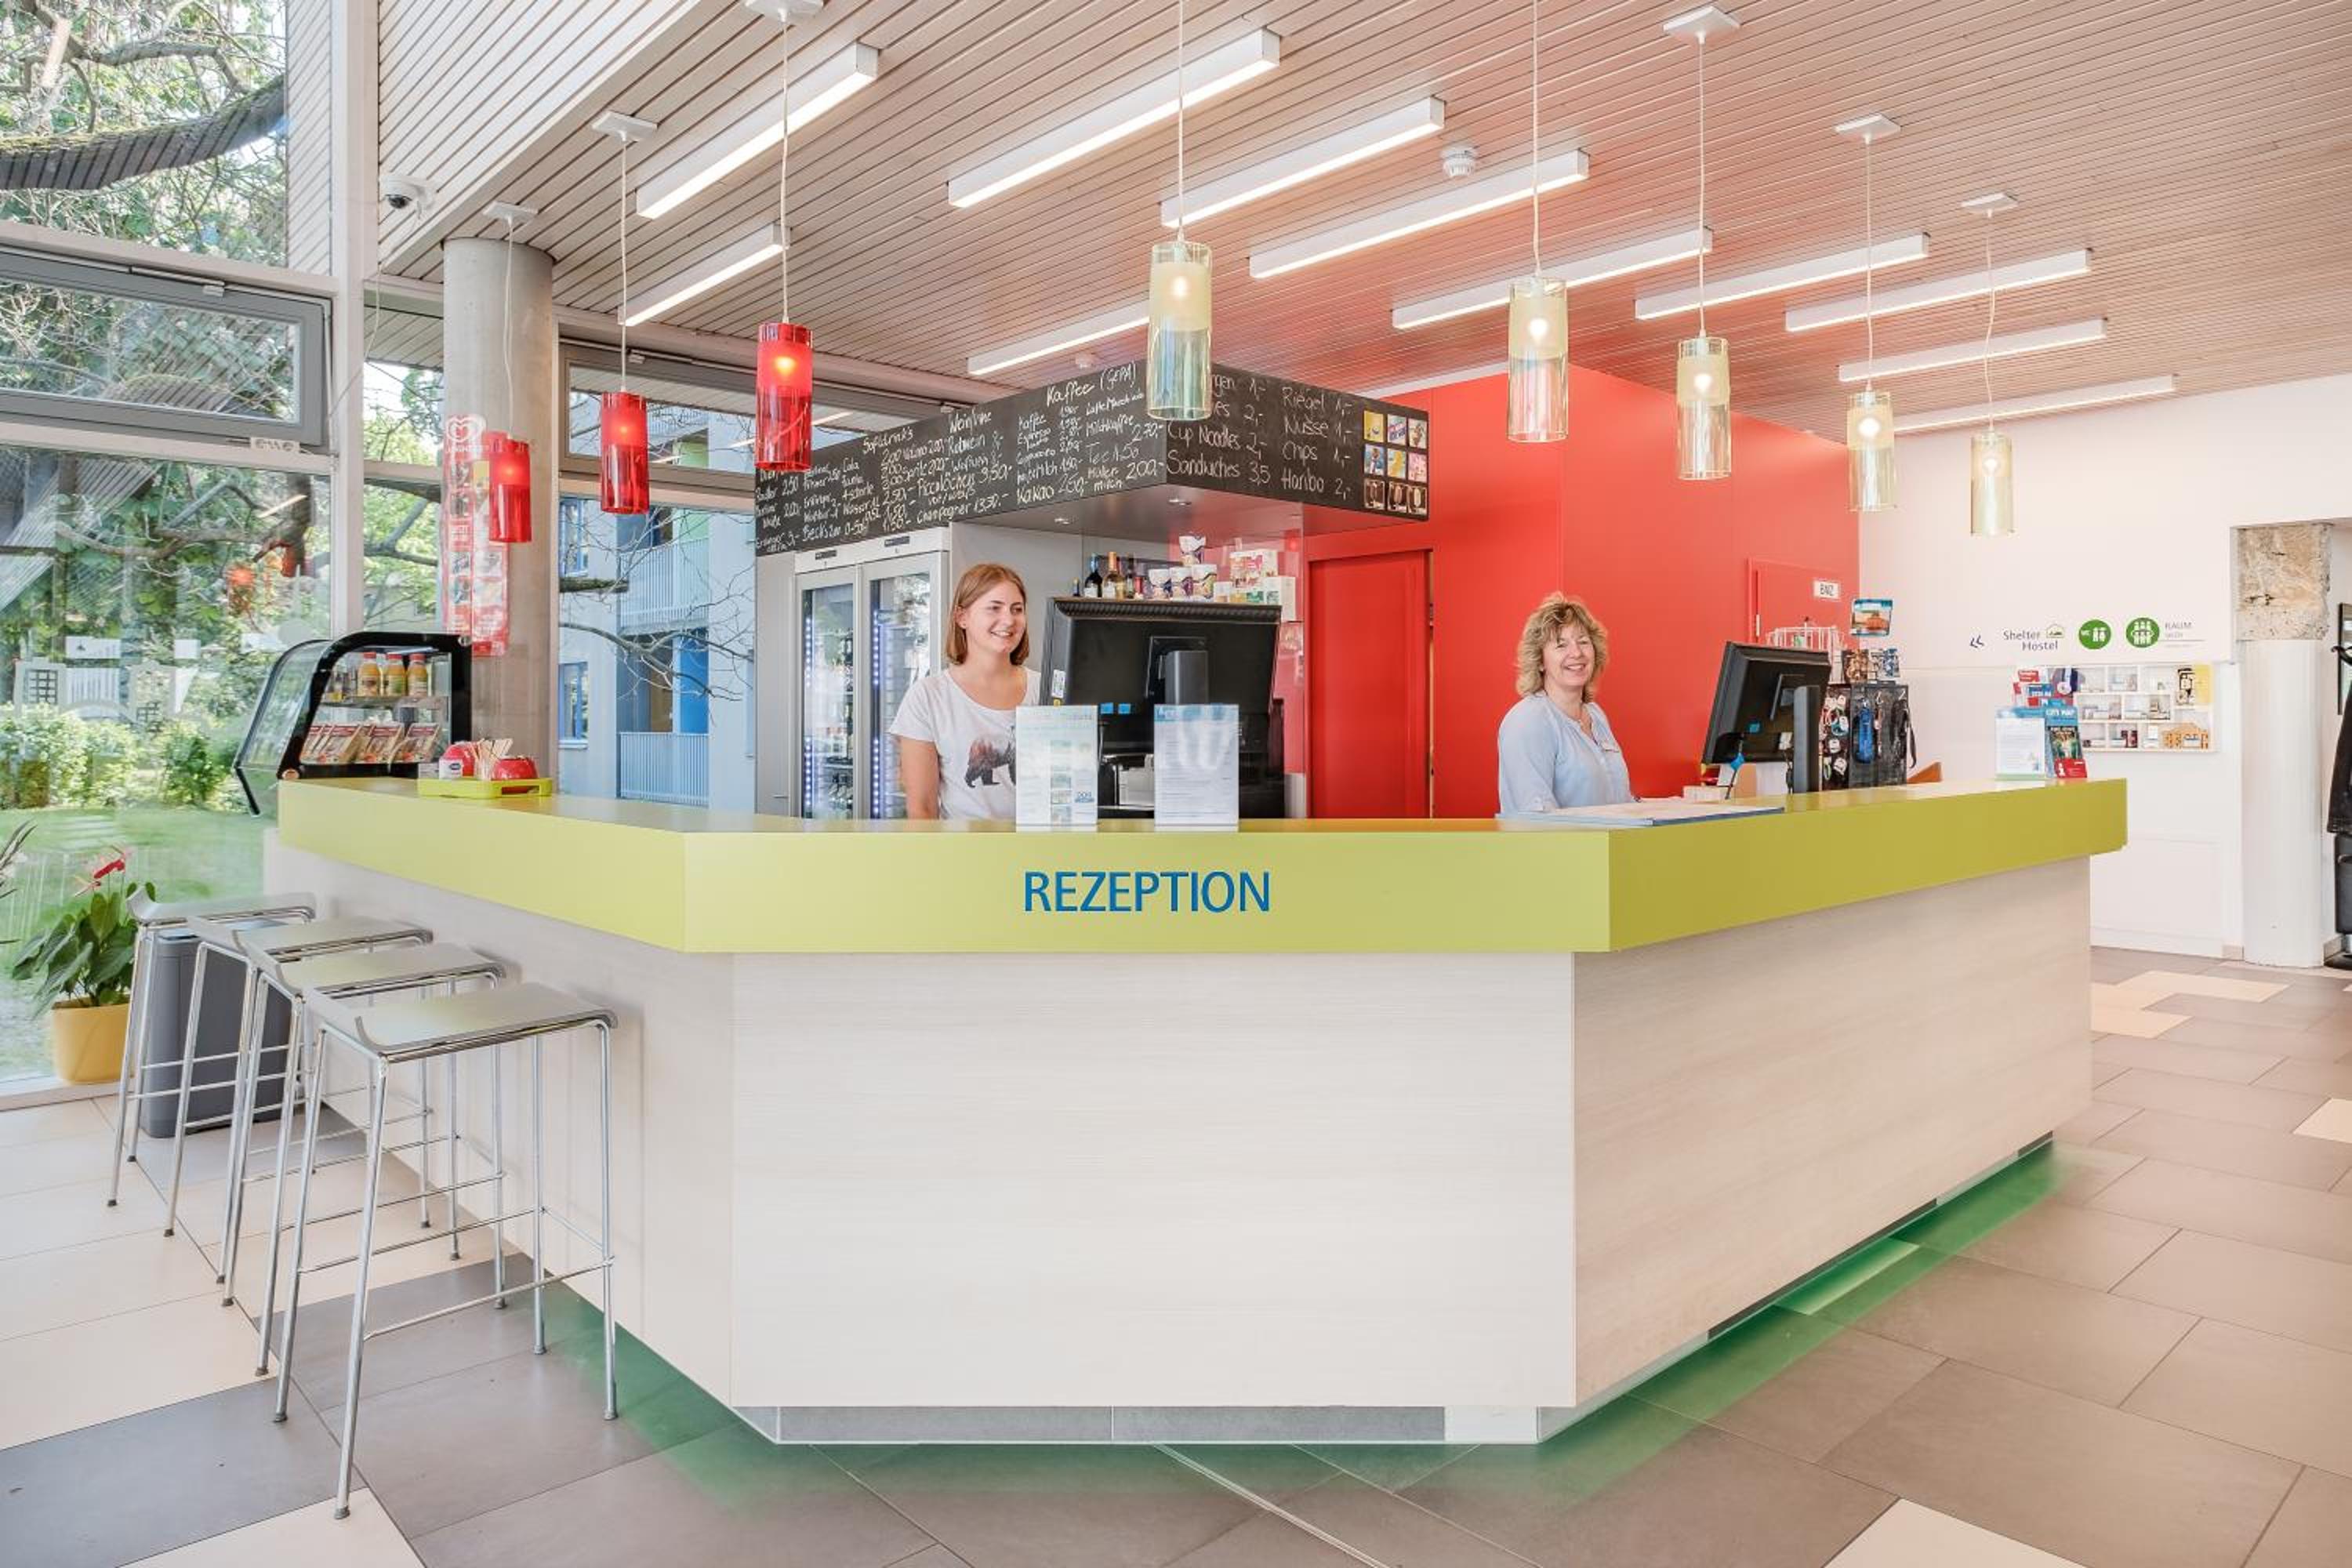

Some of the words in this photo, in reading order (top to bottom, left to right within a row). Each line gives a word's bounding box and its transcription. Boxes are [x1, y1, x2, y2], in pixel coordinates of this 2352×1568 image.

[1046, 380, 1095, 408] Kaffee
[1167, 420, 1193, 448] Cup
[1199, 424, 1241, 450] Noodles
[2002, 630, 2042, 641] Shelter
[2021, 640, 2059, 652] Hostel
[1023, 870, 1271, 913] REZEPTION
